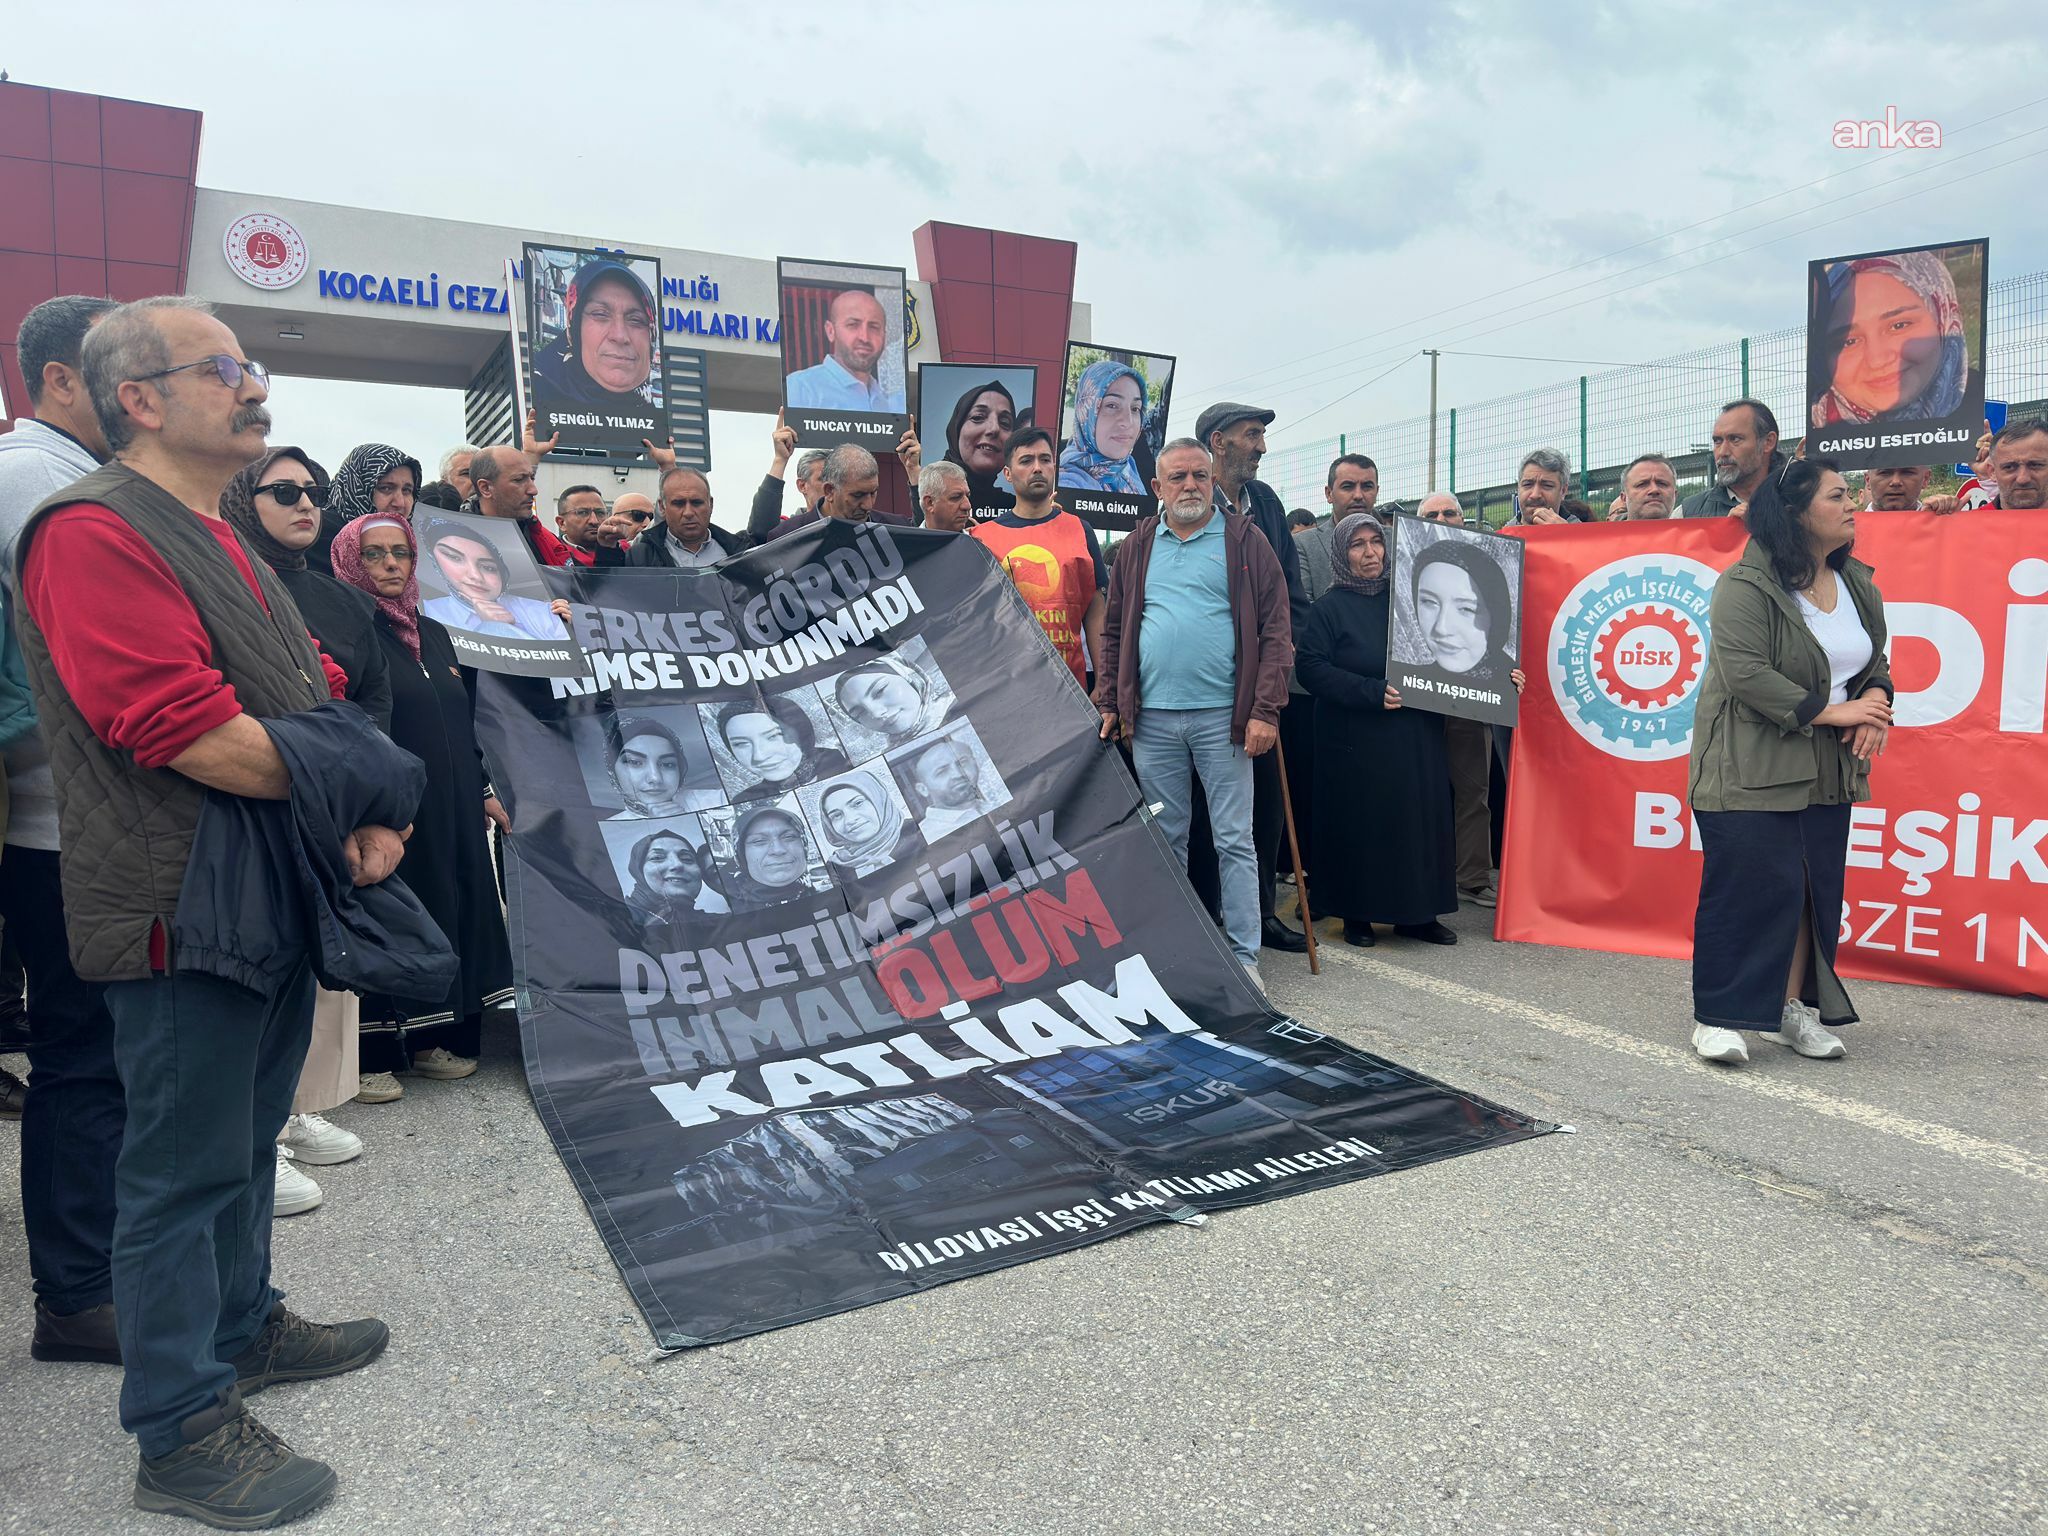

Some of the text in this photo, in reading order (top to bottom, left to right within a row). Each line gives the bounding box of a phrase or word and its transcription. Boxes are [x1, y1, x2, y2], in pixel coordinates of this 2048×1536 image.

[318, 270, 439, 309] KOCAELİ
[662, 307, 748, 340] UMLARI
[663, 275, 719, 302] NLIĞI
[549, 412, 654, 430] ŞENGÜL YILMAZ
[803, 420, 894, 435] TUNCAY YILDIZ
[1819, 427, 1969, 453] CANSU ESETOĞLU
[1075, 500, 1139, 515] ESMA GİKAN
[571, 522, 905, 654] ERKES GÖRDÜ
[1583, 585, 1636, 626] METAL
[689, 575, 925, 689] DOKUNMADI
[1035, 609, 1066, 623] KIN
[450, 635, 571, 661] UĞBA TAŞDEMİR
[1571, 628, 1597, 704] BİRLEŞİK
[1620, 641, 1674, 666] DİSK
[1402, 674, 1502, 705] NİSA TAŞDEMİR
[1621, 717, 1667, 732] 1947
[618, 810, 1079, 1005] DENETİMSİZLİK
[870, 867, 1124, 1020] ÖLÜM
[1964, 913, 1987, 963] 1
[650, 953, 1202, 1128] KATLİAM
[1035, 1198, 1117, 1232] İŞÇİ
[1253, 1137, 1384, 1179] AİLELERİ
